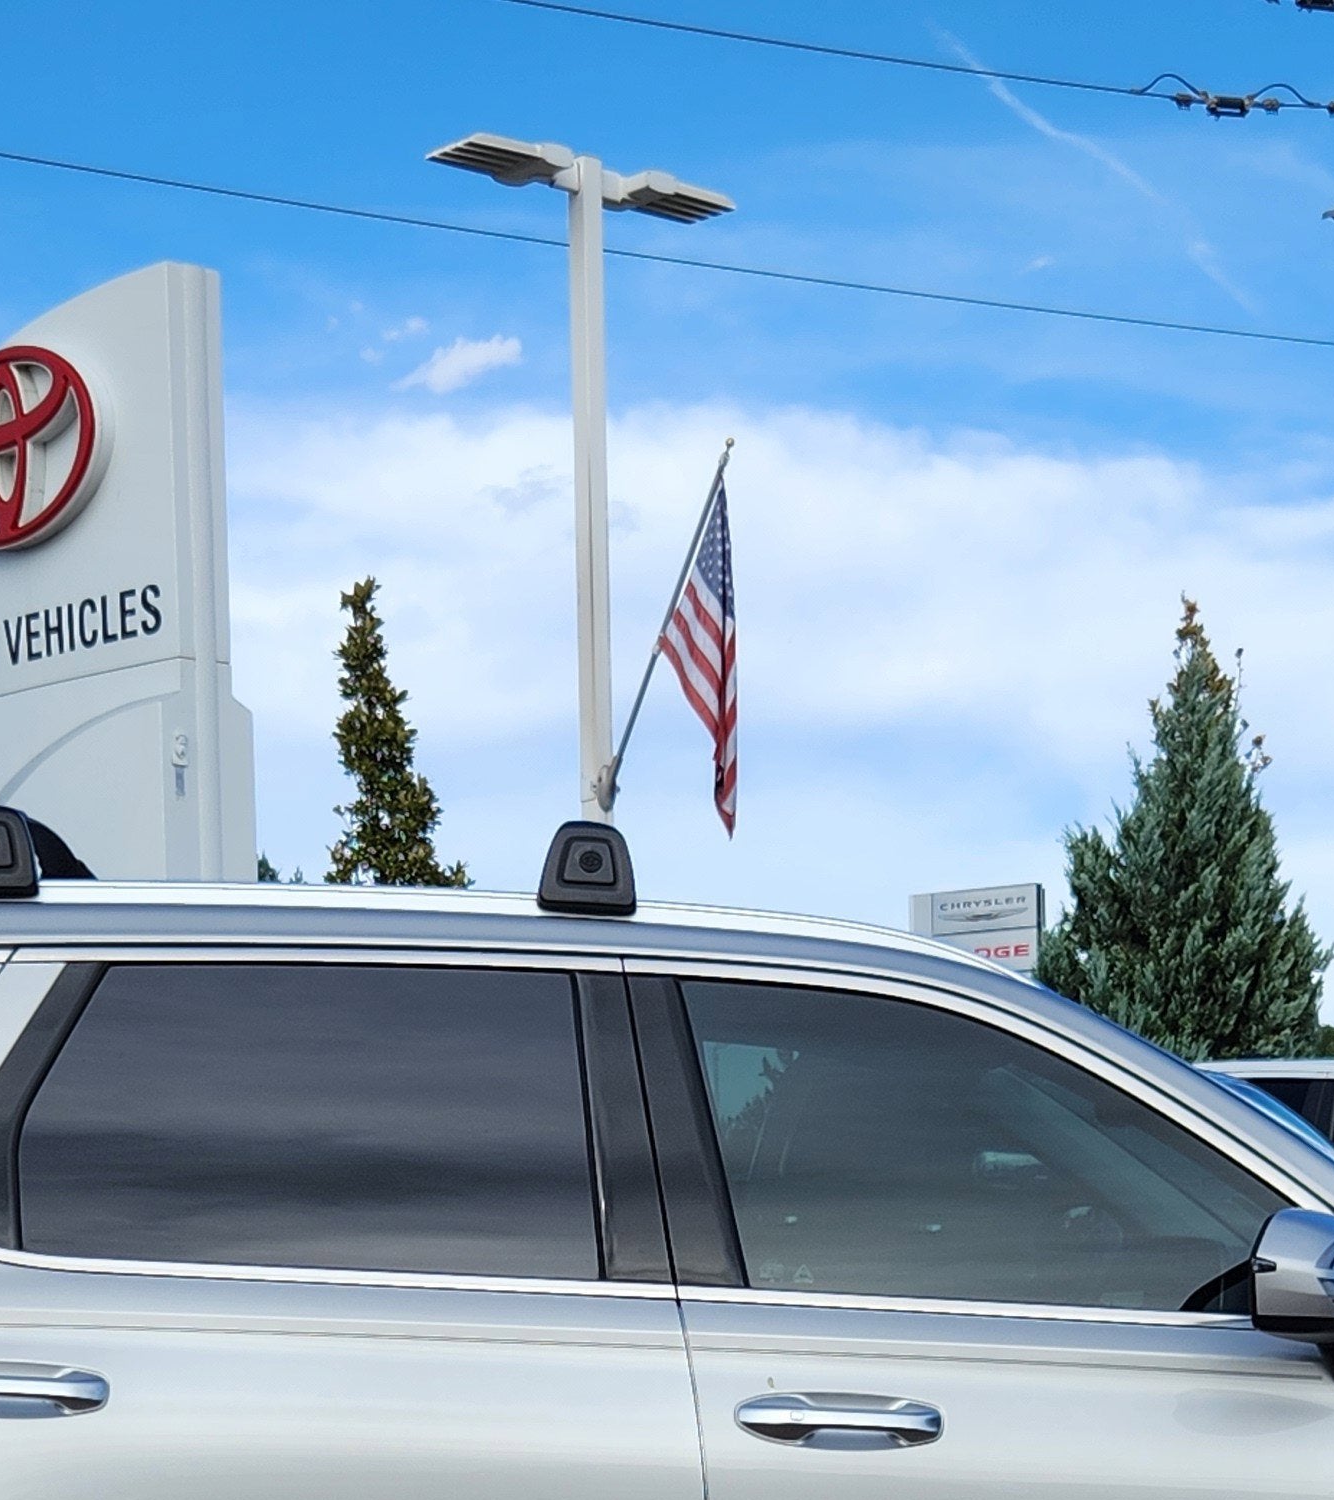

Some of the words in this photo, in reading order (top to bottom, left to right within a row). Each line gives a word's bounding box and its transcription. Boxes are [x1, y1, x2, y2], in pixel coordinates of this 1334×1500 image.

[3, 584, 163, 666] VEHICLES
[939, 895, 1027, 912] CHRYSLER
[973, 943, 1030, 959] DGE
